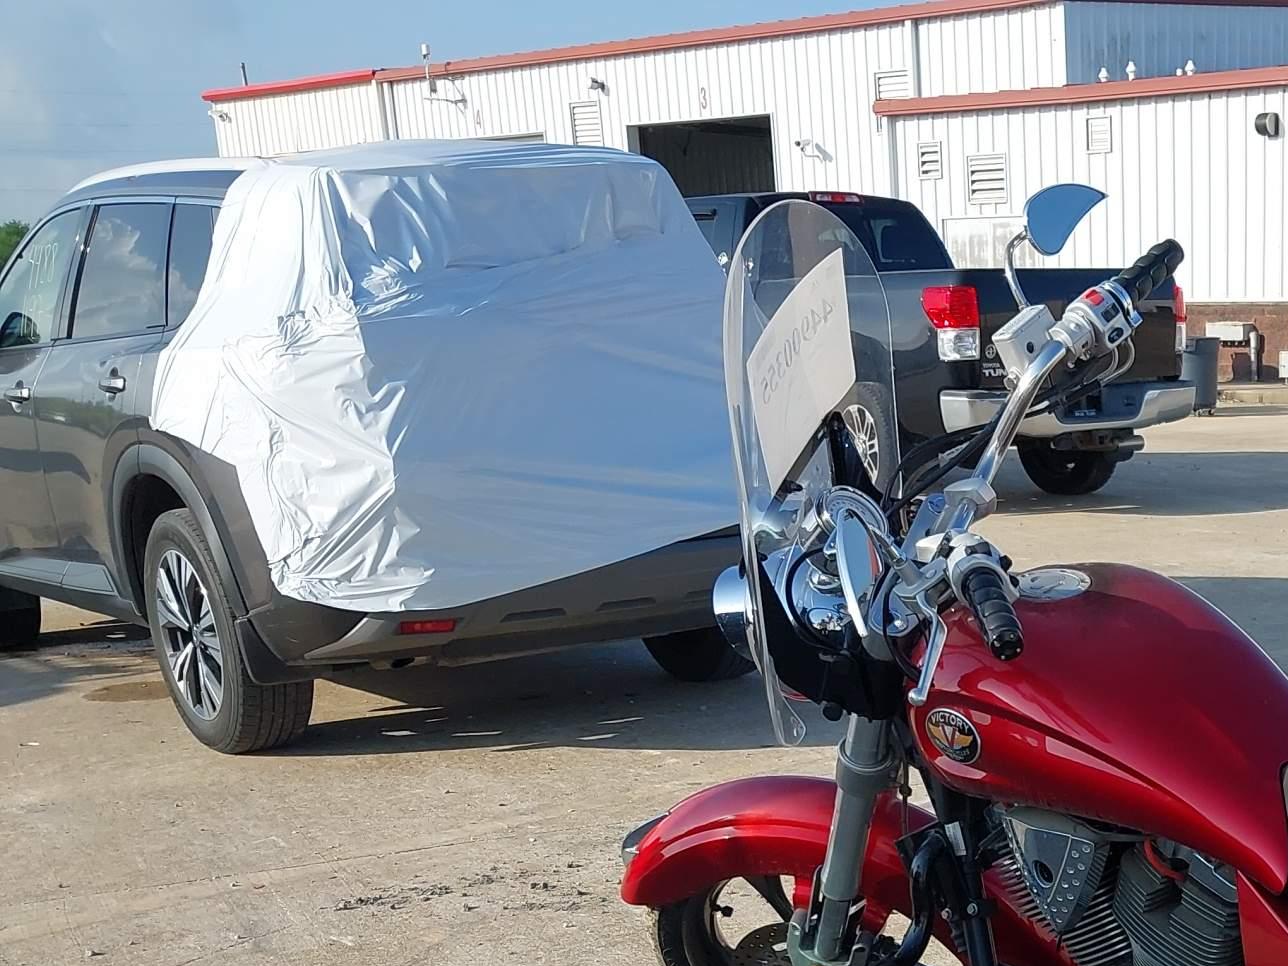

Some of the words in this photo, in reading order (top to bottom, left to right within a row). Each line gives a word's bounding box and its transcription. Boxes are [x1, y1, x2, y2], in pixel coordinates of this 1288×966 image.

[699, 87, 709, 109] 3
[475, 109, 482, 129] 4
[930, 712, 970, 734] VICTORY
